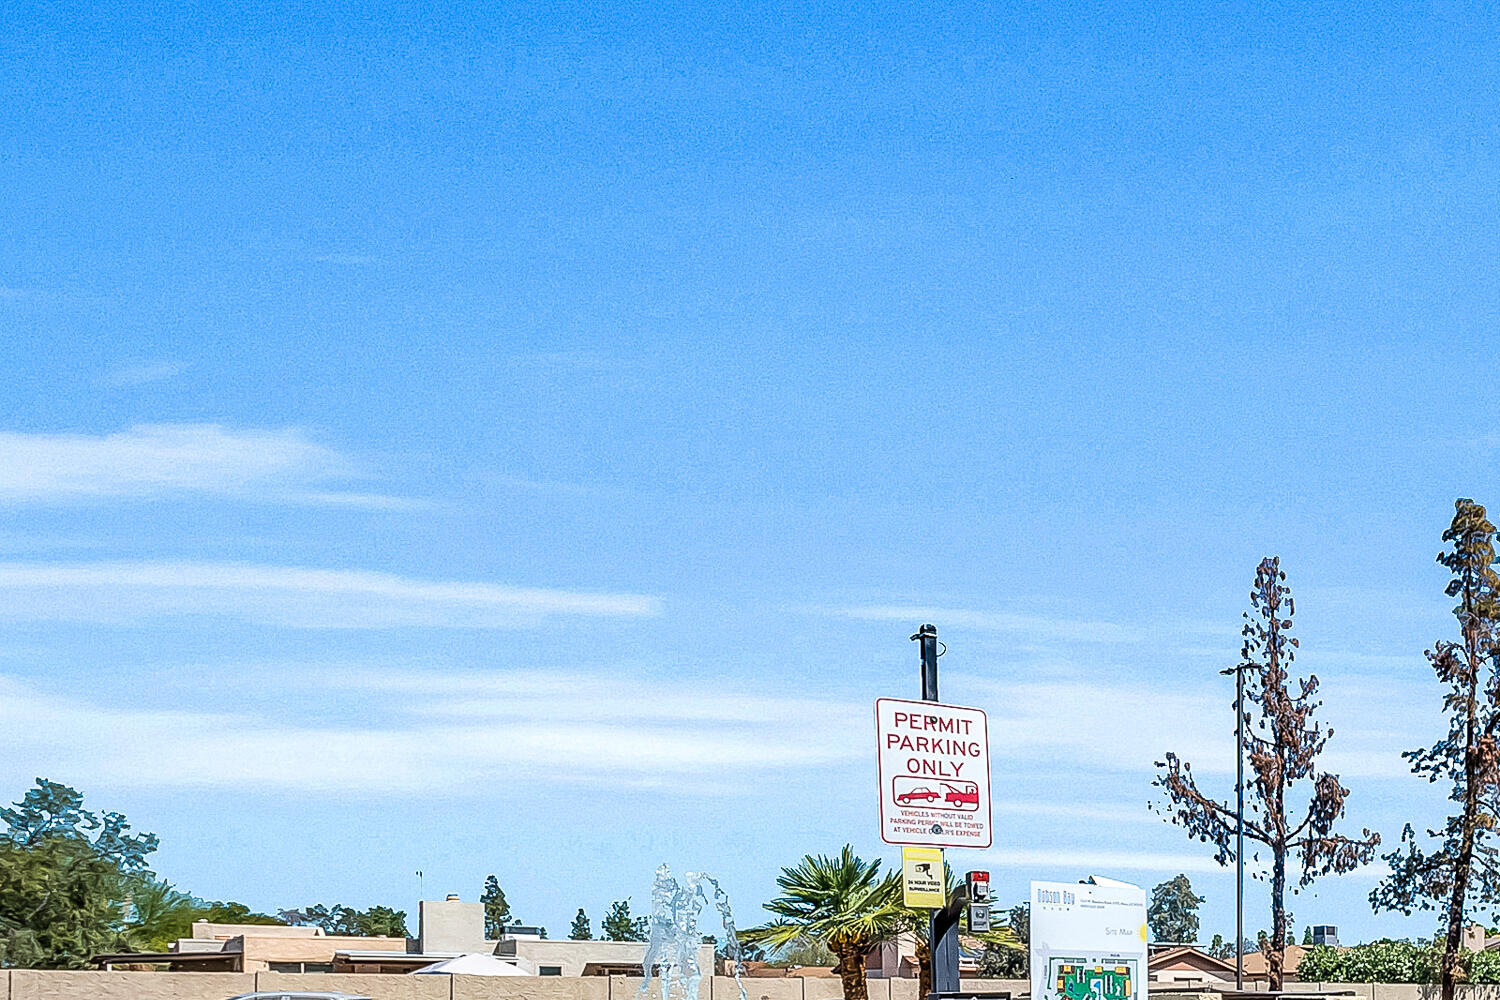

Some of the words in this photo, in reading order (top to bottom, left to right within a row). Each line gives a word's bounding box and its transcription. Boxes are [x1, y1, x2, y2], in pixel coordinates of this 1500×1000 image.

[894, 711, 973, 735] PERMIT
[887, 733, 981, 757] PARKING
[907, 758, 965, 777] ONLY
[890, 817, 916, 825] PARKING
[963, 822, 984, 830] TOWED
[900, 810, 930, 818] VEHICLES
